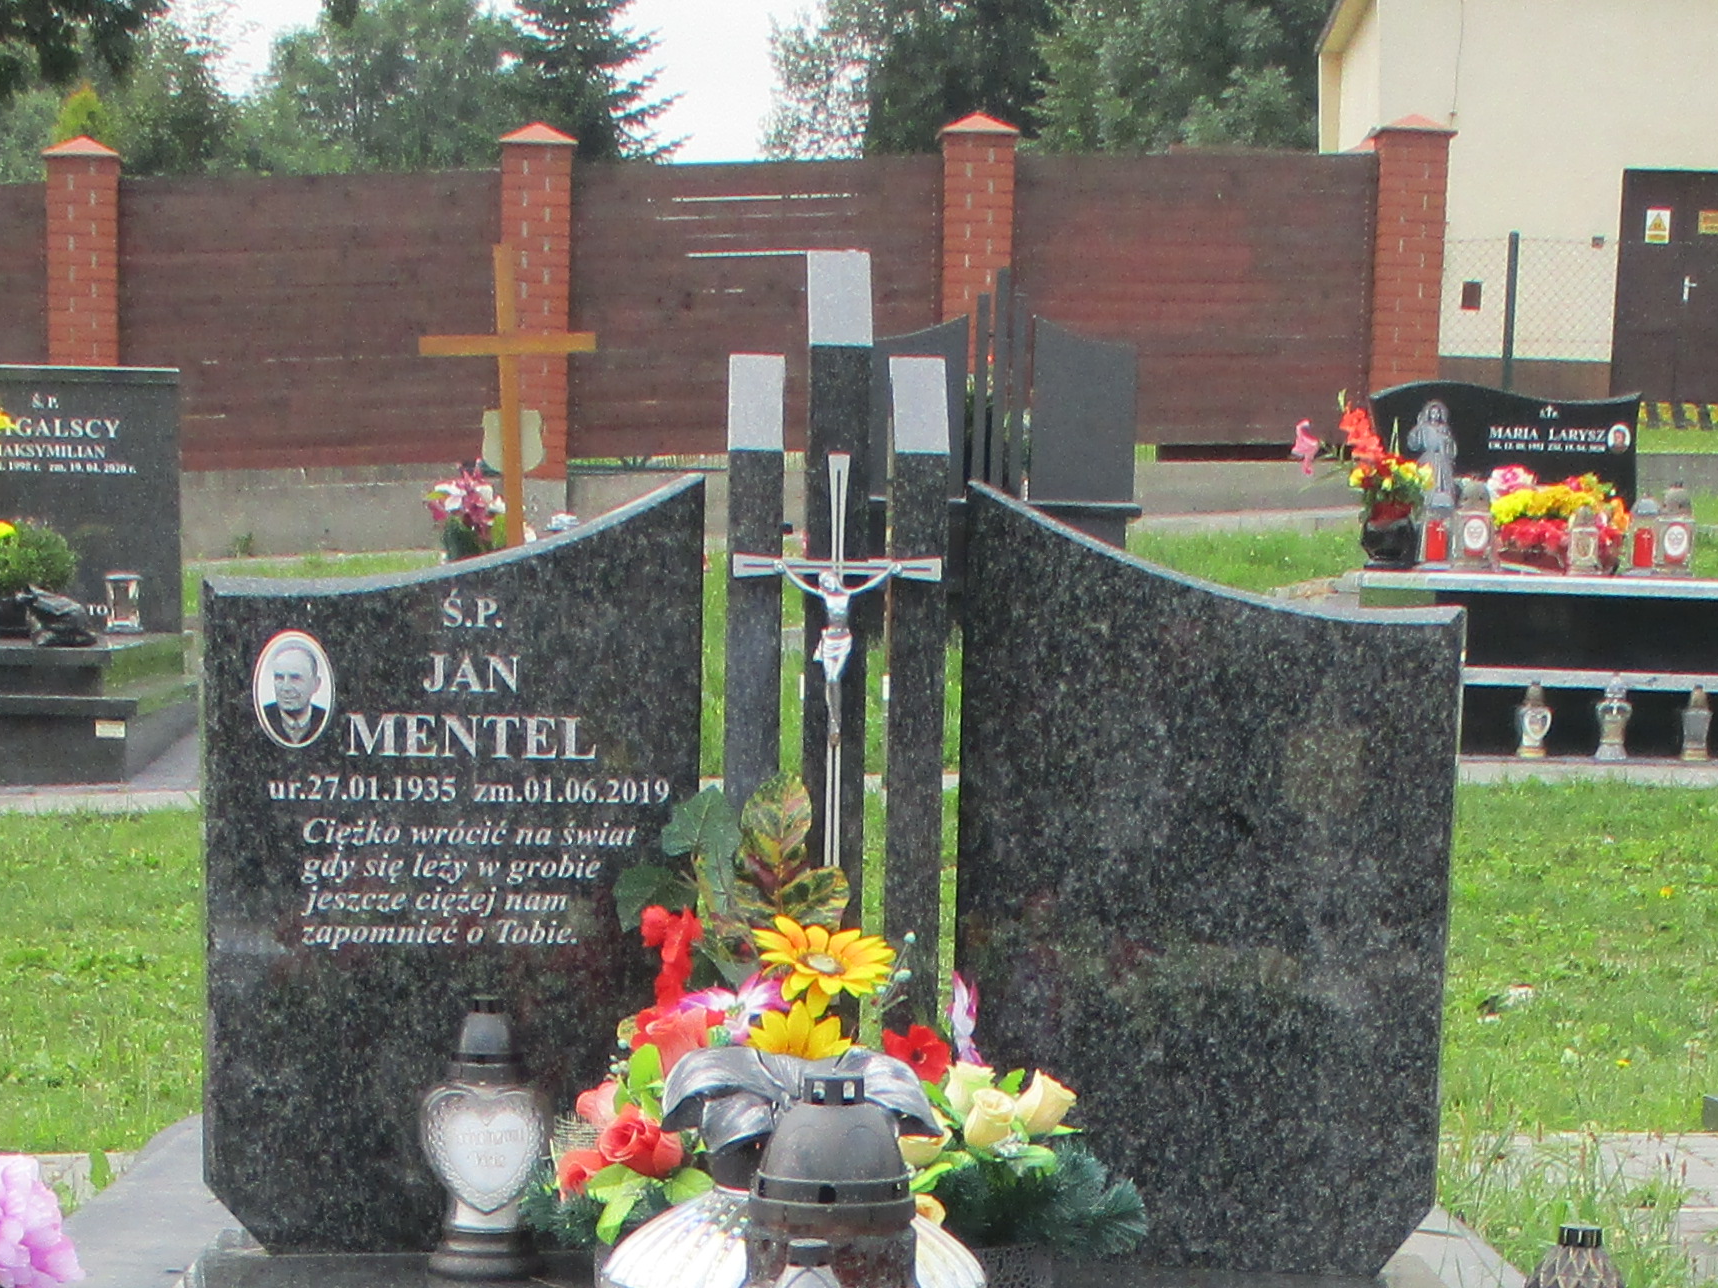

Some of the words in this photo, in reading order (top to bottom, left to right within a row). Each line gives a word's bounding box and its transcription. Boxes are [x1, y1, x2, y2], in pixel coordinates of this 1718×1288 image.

[1489, 426, 1539, 440] MARIA
[1548, 427, 1607, 442] LARYSZ
[442, 590, 503, 628] Ś.P.
[423, 652, 521, 694] JAN
[345, 712, 596, 760] MENTEL
[269, 775, 457, 801] ur.27.01.1935
[474, 777, 671, 804] zm.01.06.2019
[302, 818, 400, 850] Ciężko
[411, 820, 506, 846] wrócić
[515, 825, 551, 846] na
[561, 821, 636, 848] świat
[300, 853, 355, 883] gdy
[363, 853, 404, 884] się
[412, 853, 468, 884] leży
[477, 858, 499, 878] w
[506, 855, 602, 885] grobie
[301, 885, 406, 916] jeszcze
[414, 886, 497, 917] ciężej
[503, 890, 569, 912] nam
[301, 919, 458, 950] zapomnieć
[467, 925, 484, 945] o
[497, 919, 579, 945] Tobie.
